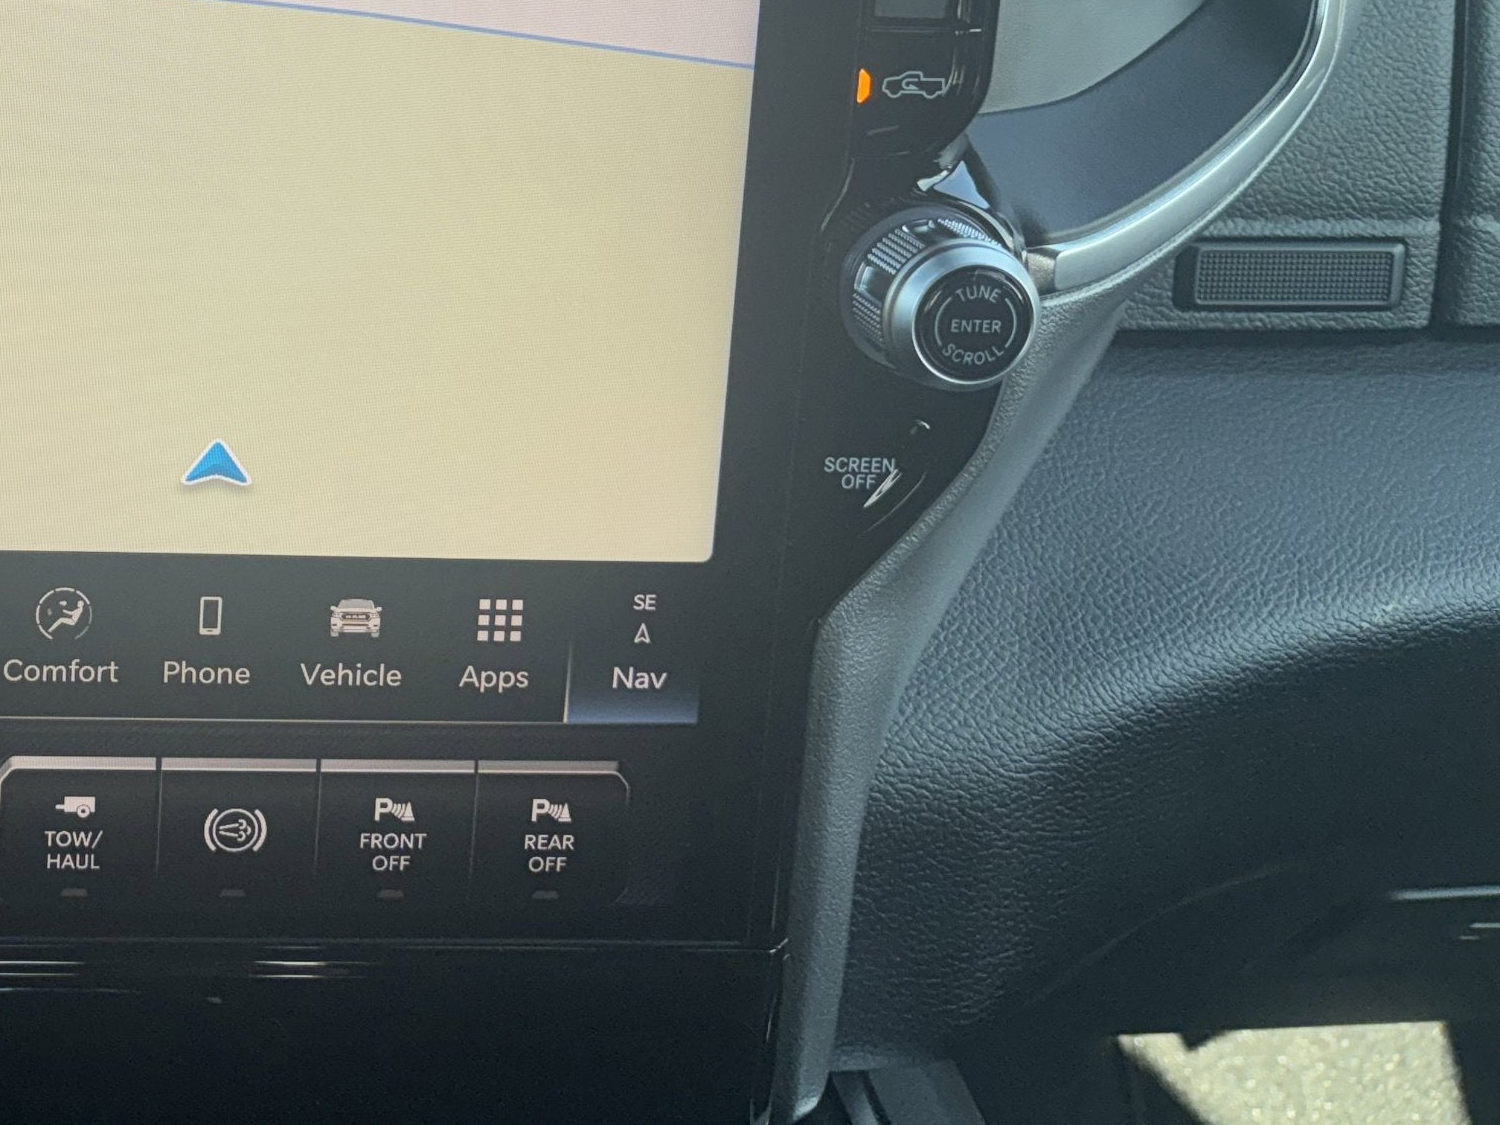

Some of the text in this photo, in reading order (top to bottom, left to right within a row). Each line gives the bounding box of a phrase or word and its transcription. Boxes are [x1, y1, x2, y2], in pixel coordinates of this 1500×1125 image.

[954, 284, 1003, 304] TUNE
[950, 319, 1002, 334] ENTER
[942, 342, 1004, 366] SCROLL
[823, 456, 897, 473] SCREEN
[841, 474, 877, 490] OFF
[632, 594, 657, 612] SE
[3, 659, 120, 683] Comfort
[162, 660, 251, 685] Phone
[300, 662, 403, 688] Vehicle
[458, 665, 530, 693] Apps
[611, 666, 668, 690] Nav
[44, 830, 103, 849] TOW/
[359, 832, 427, 850] FRONT
[524, 834, 575, 851] REAR
[46, 853, 100, 870] HAUL
[371, 855, 411, 872] OFF
[528, 856, 568, 873] OFF
